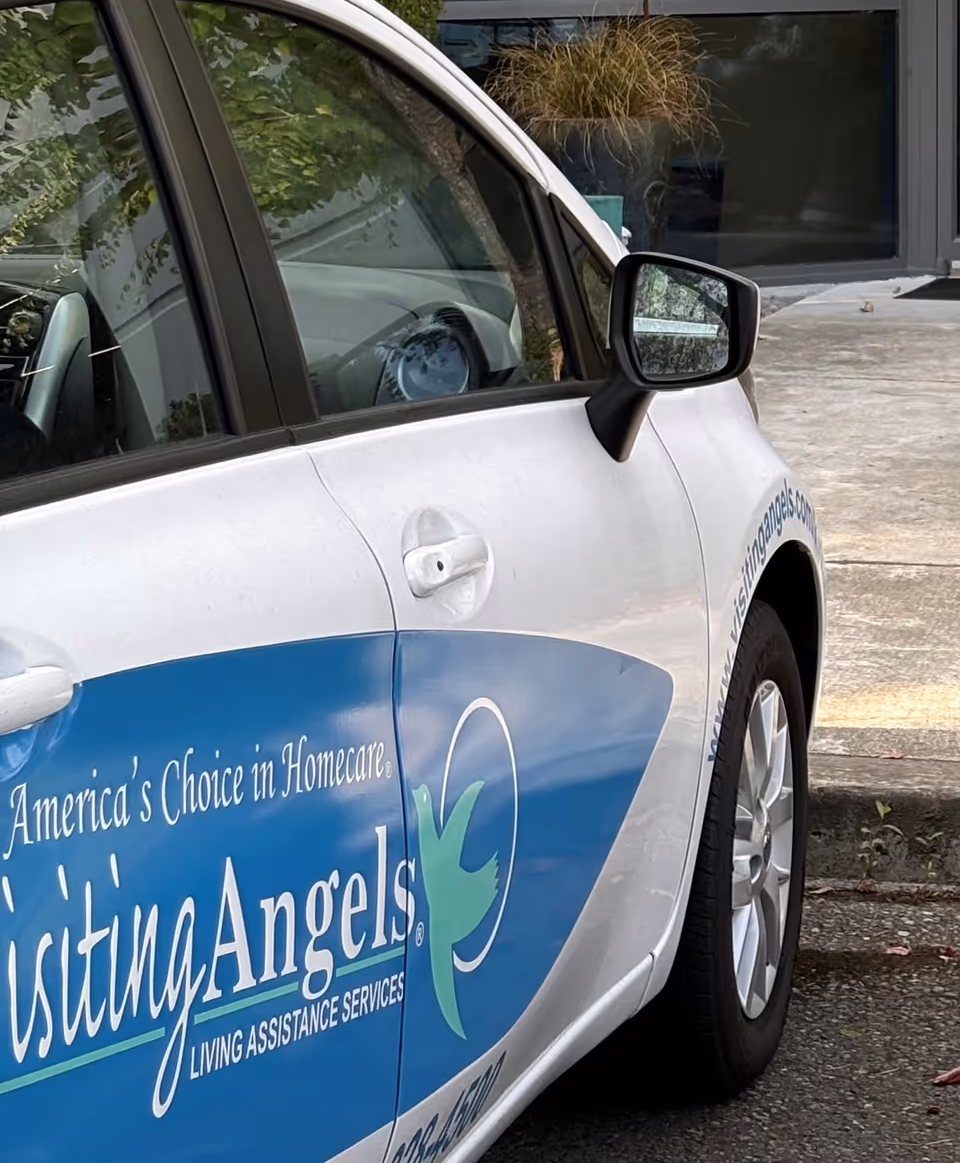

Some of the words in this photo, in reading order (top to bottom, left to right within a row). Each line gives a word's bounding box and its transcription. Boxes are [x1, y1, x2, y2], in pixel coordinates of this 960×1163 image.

[2, 755, 152, 860] America's
[161, 747, 244, 826] Choice
[251, 743, 276, 802] in
[190, 1029, 243, 1080] LIVING
[245, 995, 340, 1060] ASSISTANCE
[342, 970, 404, 1024] SERVICES
